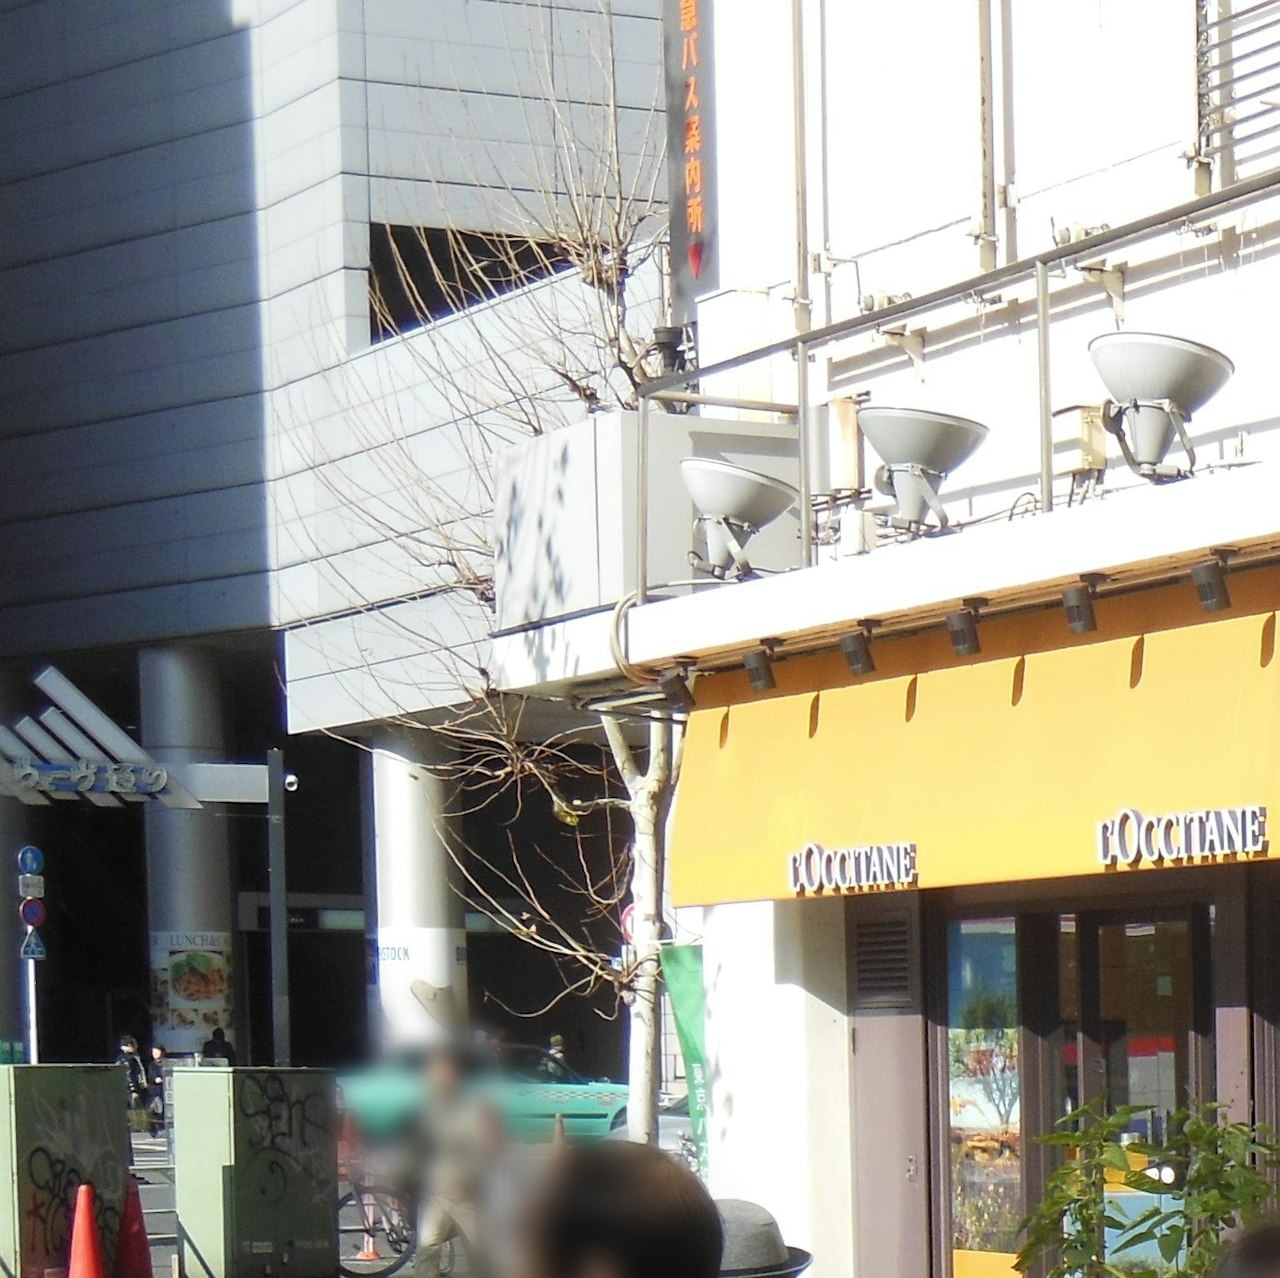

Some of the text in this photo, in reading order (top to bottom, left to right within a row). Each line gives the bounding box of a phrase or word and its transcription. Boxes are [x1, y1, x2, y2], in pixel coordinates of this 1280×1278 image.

[1097, 804, 1267, 865] L'OCCITANE
[788, 842, 915, 892] L'OCCITANE
[377, 947, 411, 961] STOCK
